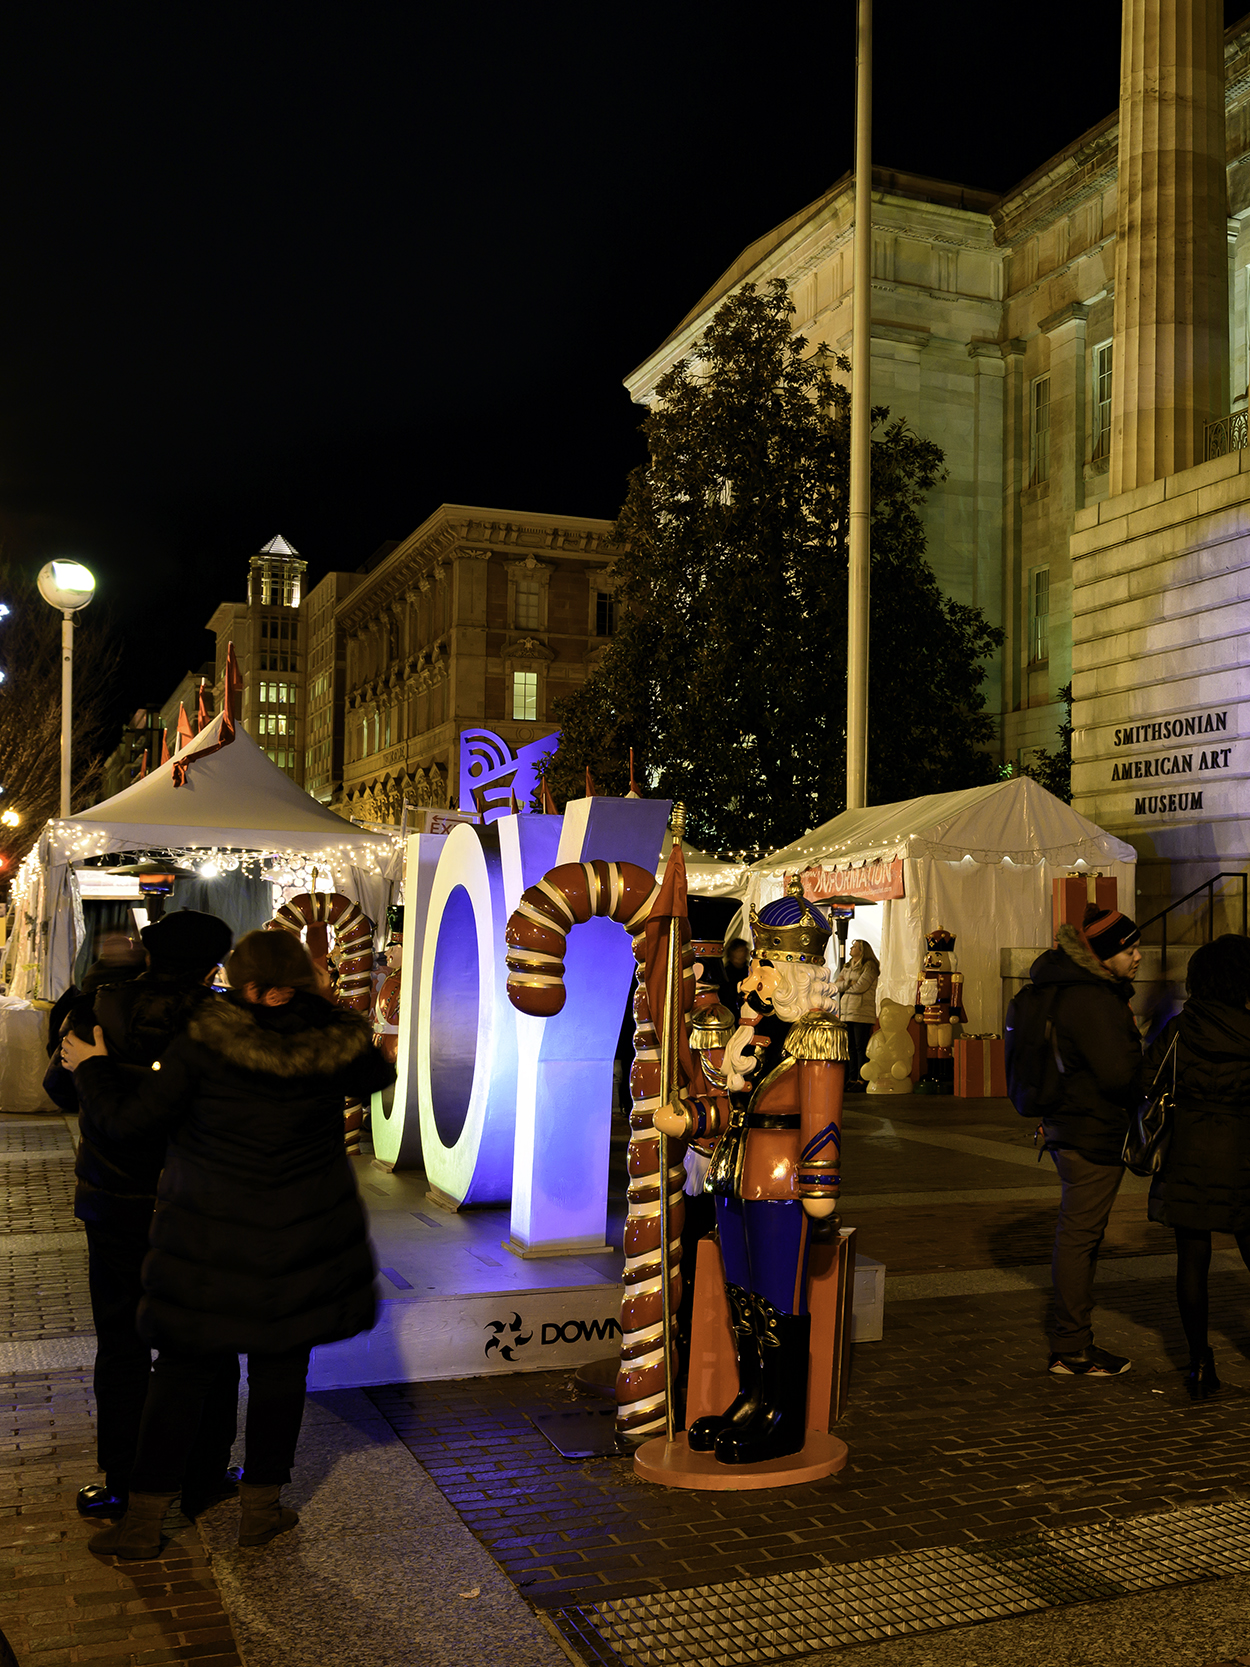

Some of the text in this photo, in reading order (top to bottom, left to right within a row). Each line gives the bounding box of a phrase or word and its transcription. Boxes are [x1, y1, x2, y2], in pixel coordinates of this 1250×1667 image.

[1114, 711, 1228, 747] SMITHSONIAN
[1111, 747, 1232, 782] AMERICAN ART
[1134, 791, 1204, 816] MUSEUM
